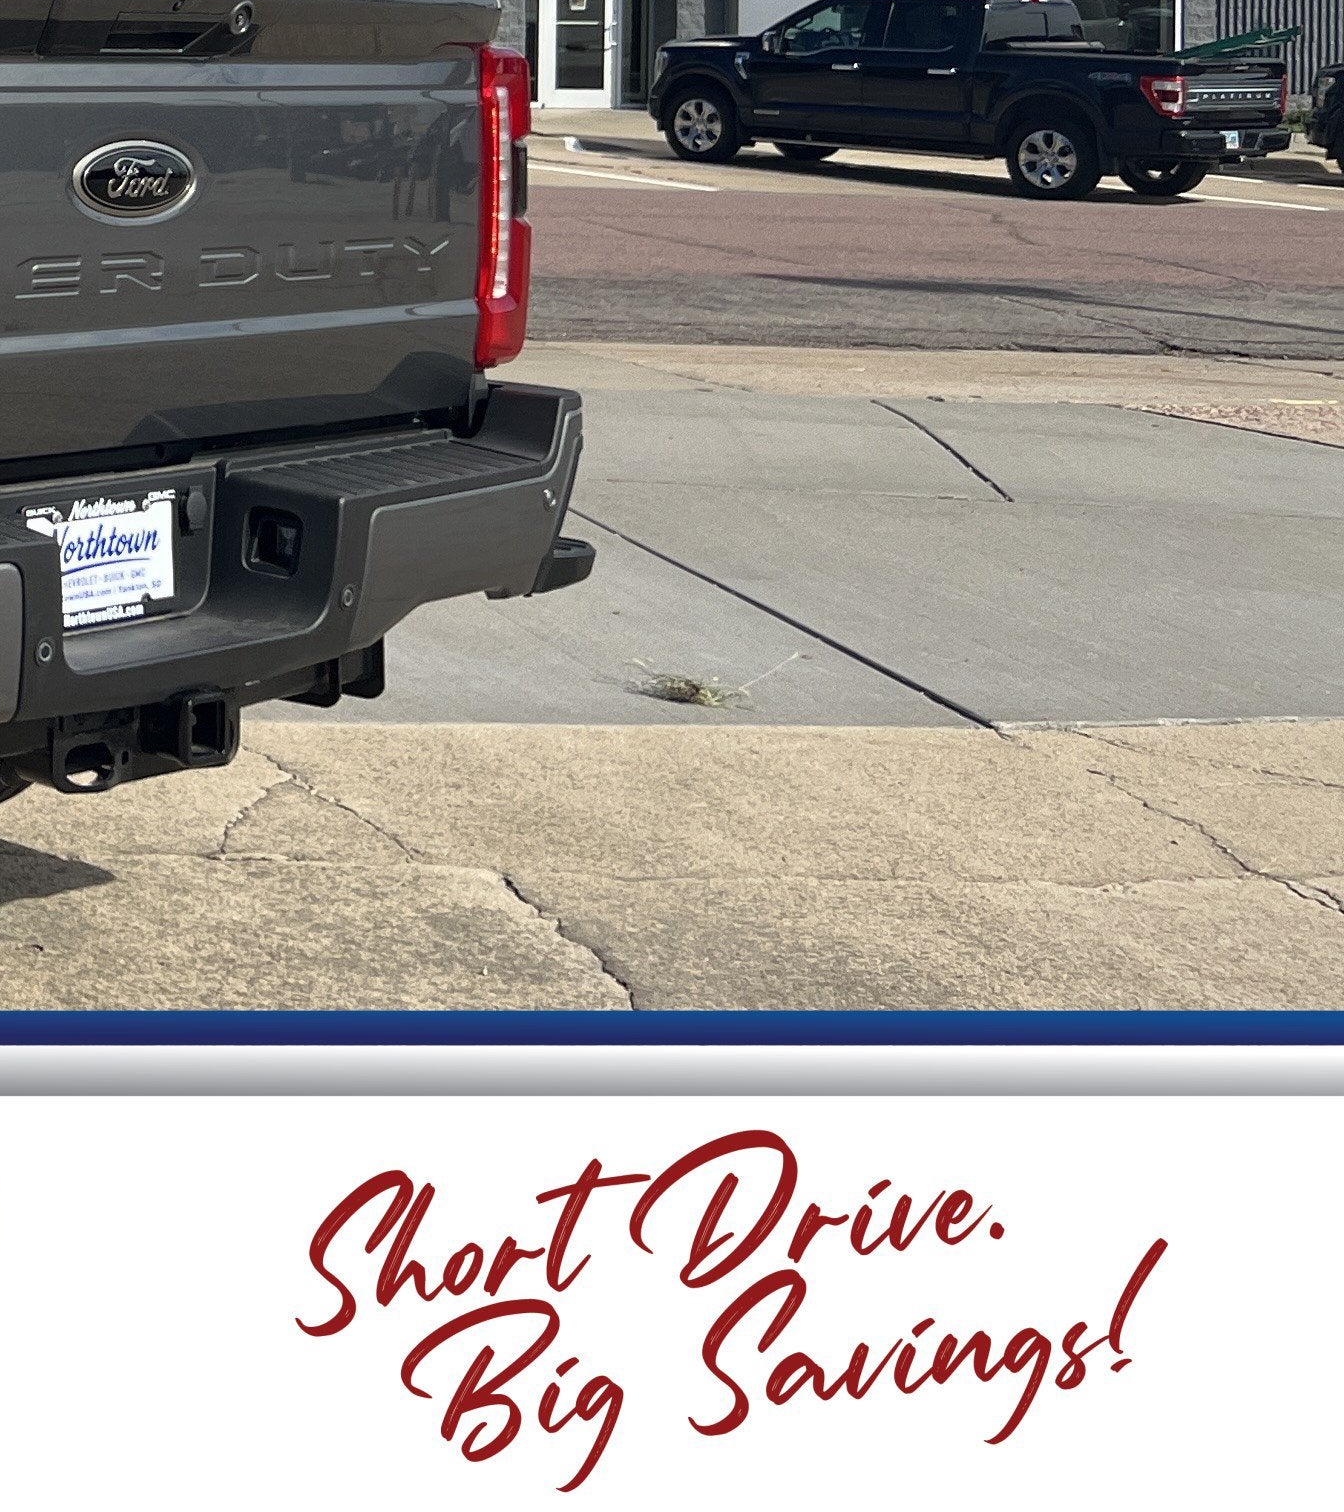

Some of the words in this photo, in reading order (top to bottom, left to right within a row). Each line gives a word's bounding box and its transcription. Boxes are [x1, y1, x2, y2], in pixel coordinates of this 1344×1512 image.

[1202, 92, 1272, 101] PLATINUM
[107, 156, 174, 199] Ford
[198, 232, 456, 289] DUTY
[148, 489, 176, 501] GMC
[25, 506, 57, 517] BUICK
[68, 497, 137, 522] Northtown
[63, 603, 145, 628] NorthtownUSA.com
